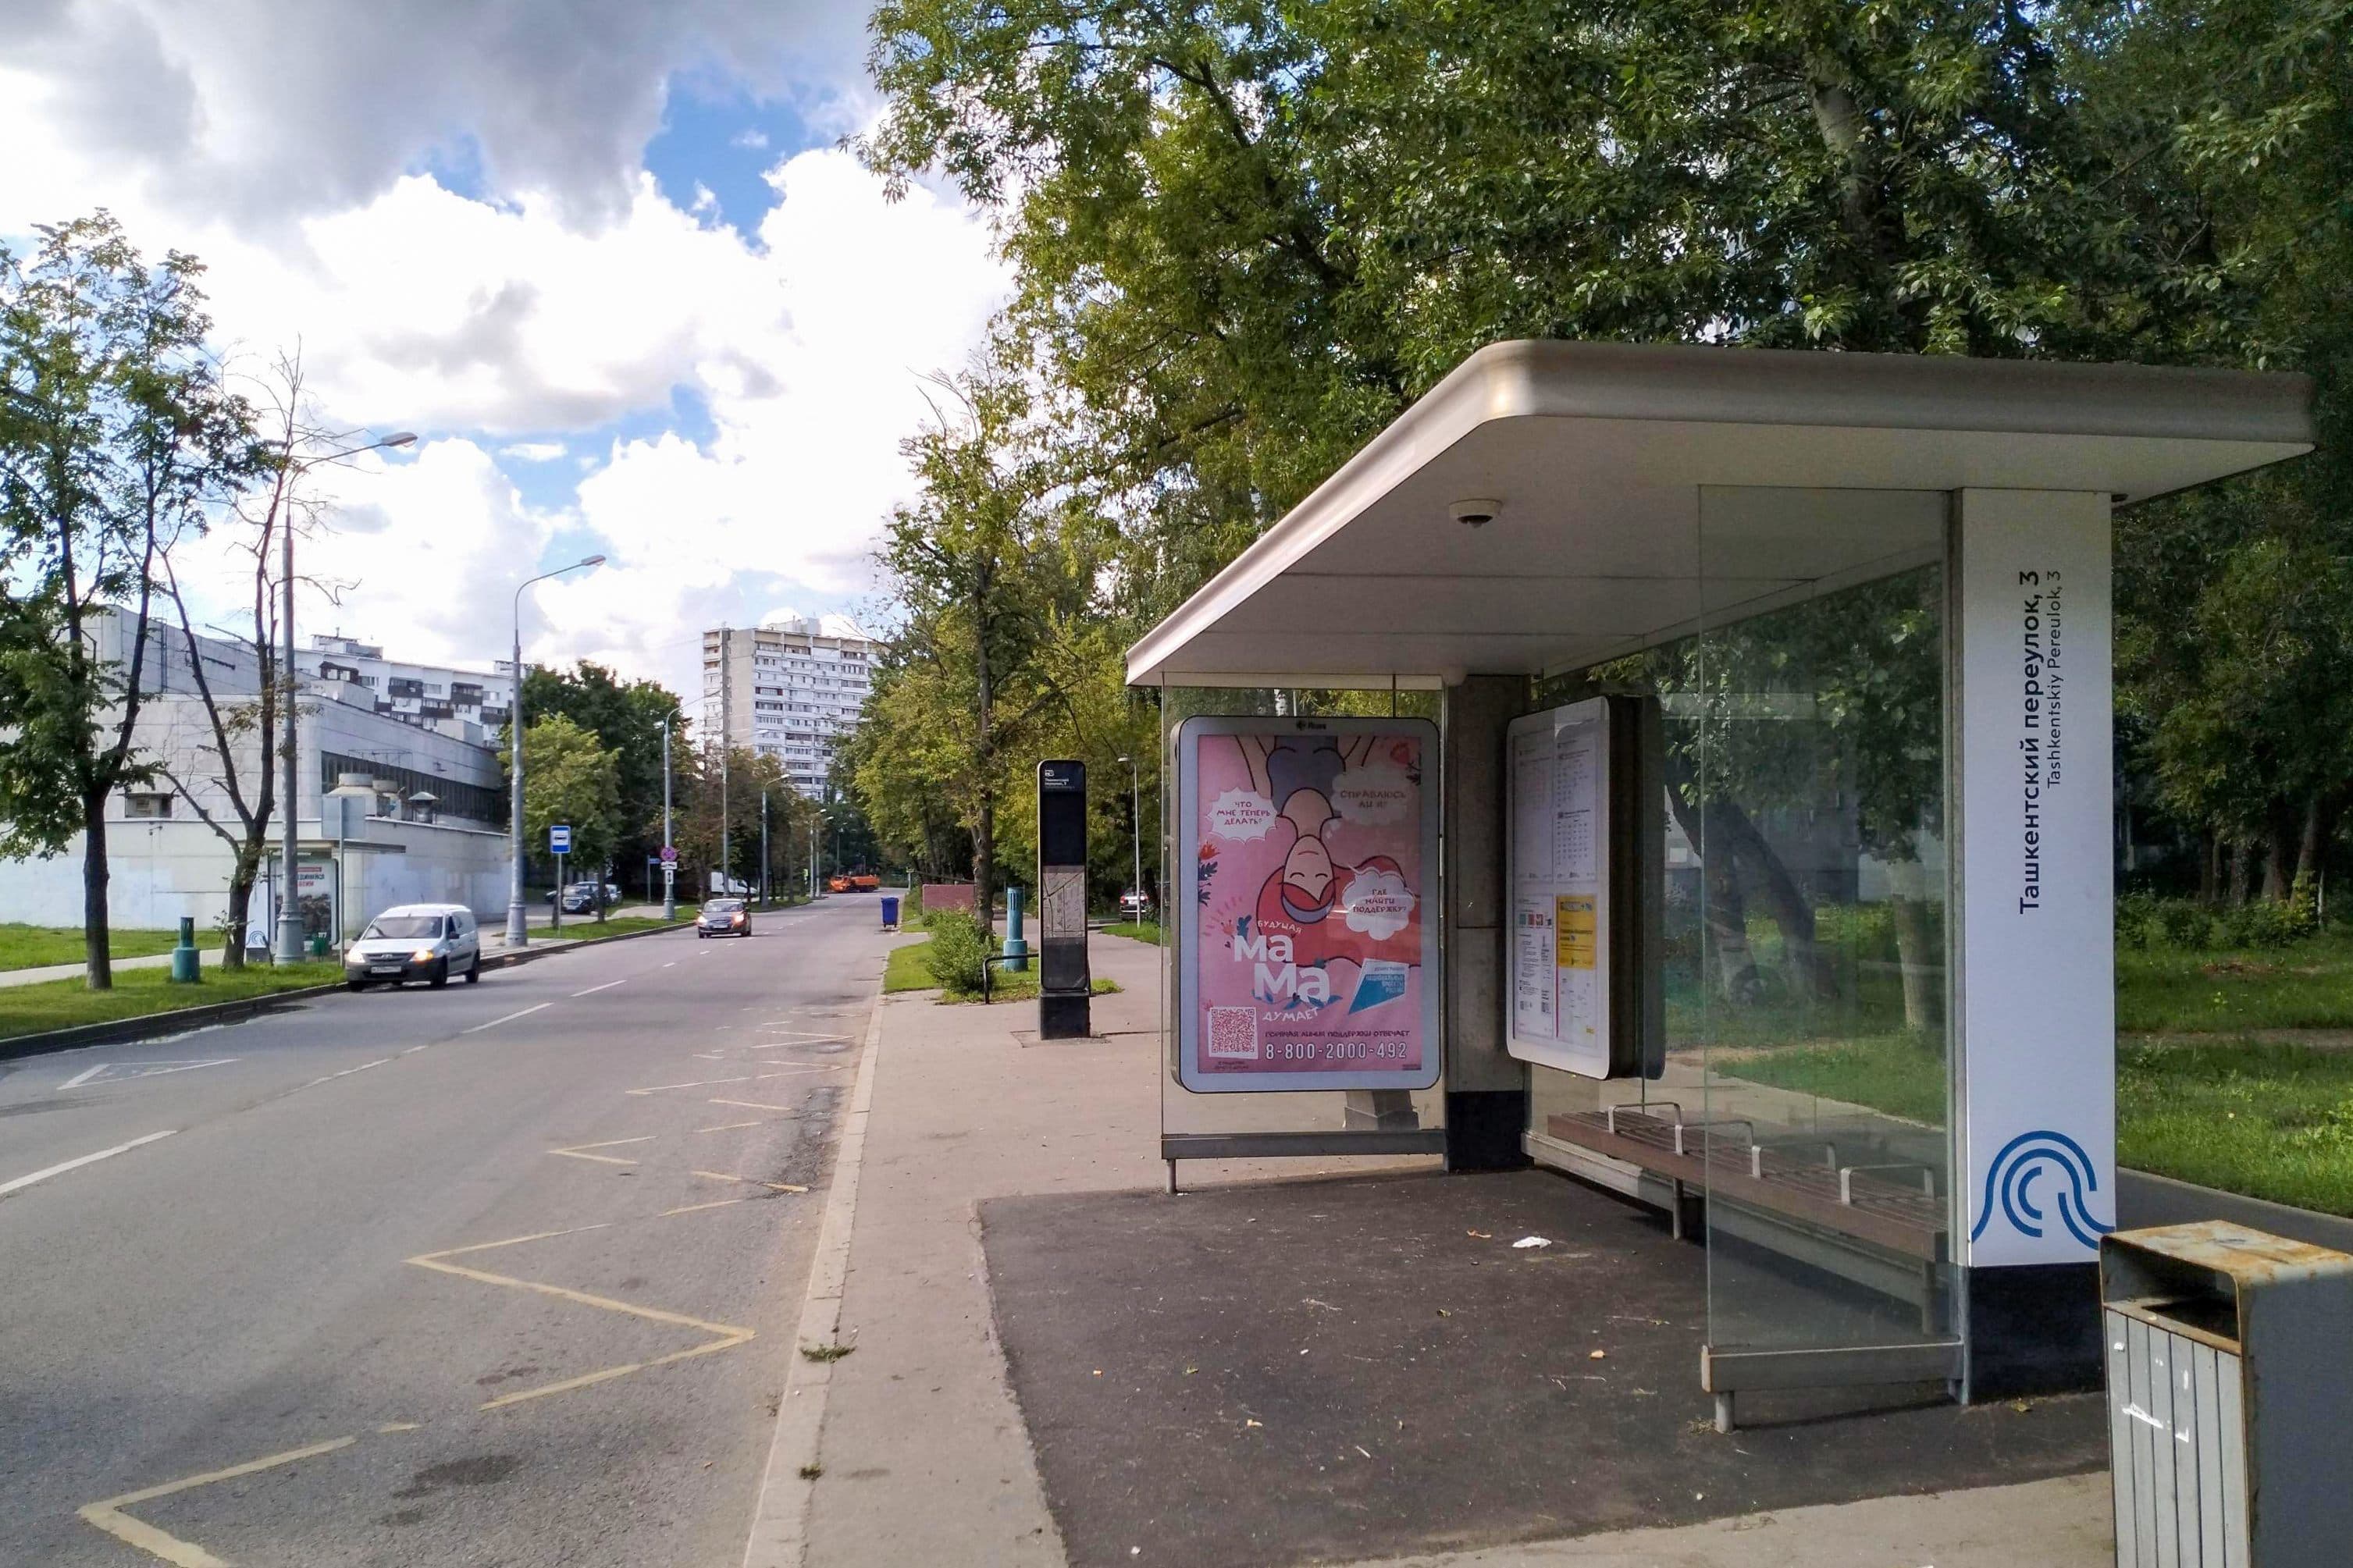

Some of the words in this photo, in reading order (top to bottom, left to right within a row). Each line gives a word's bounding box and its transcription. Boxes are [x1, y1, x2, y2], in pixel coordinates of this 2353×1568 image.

[2019, 571, 2039, 586] 3
[2047, 571, 2061, 581] 3
[2046, 586, 2063, 669] Pereulok,
[2024, 594, 2045, 728] переулок,
[2046, 674, 2064, 789] Tashkentskiy
[2019, 738, 2040, 915] Ташкентский
[1263, 1007, 1319, 1022] ДУМАЕТ
[1265, 1042, 1407, 1060] 8-800-2000-492
